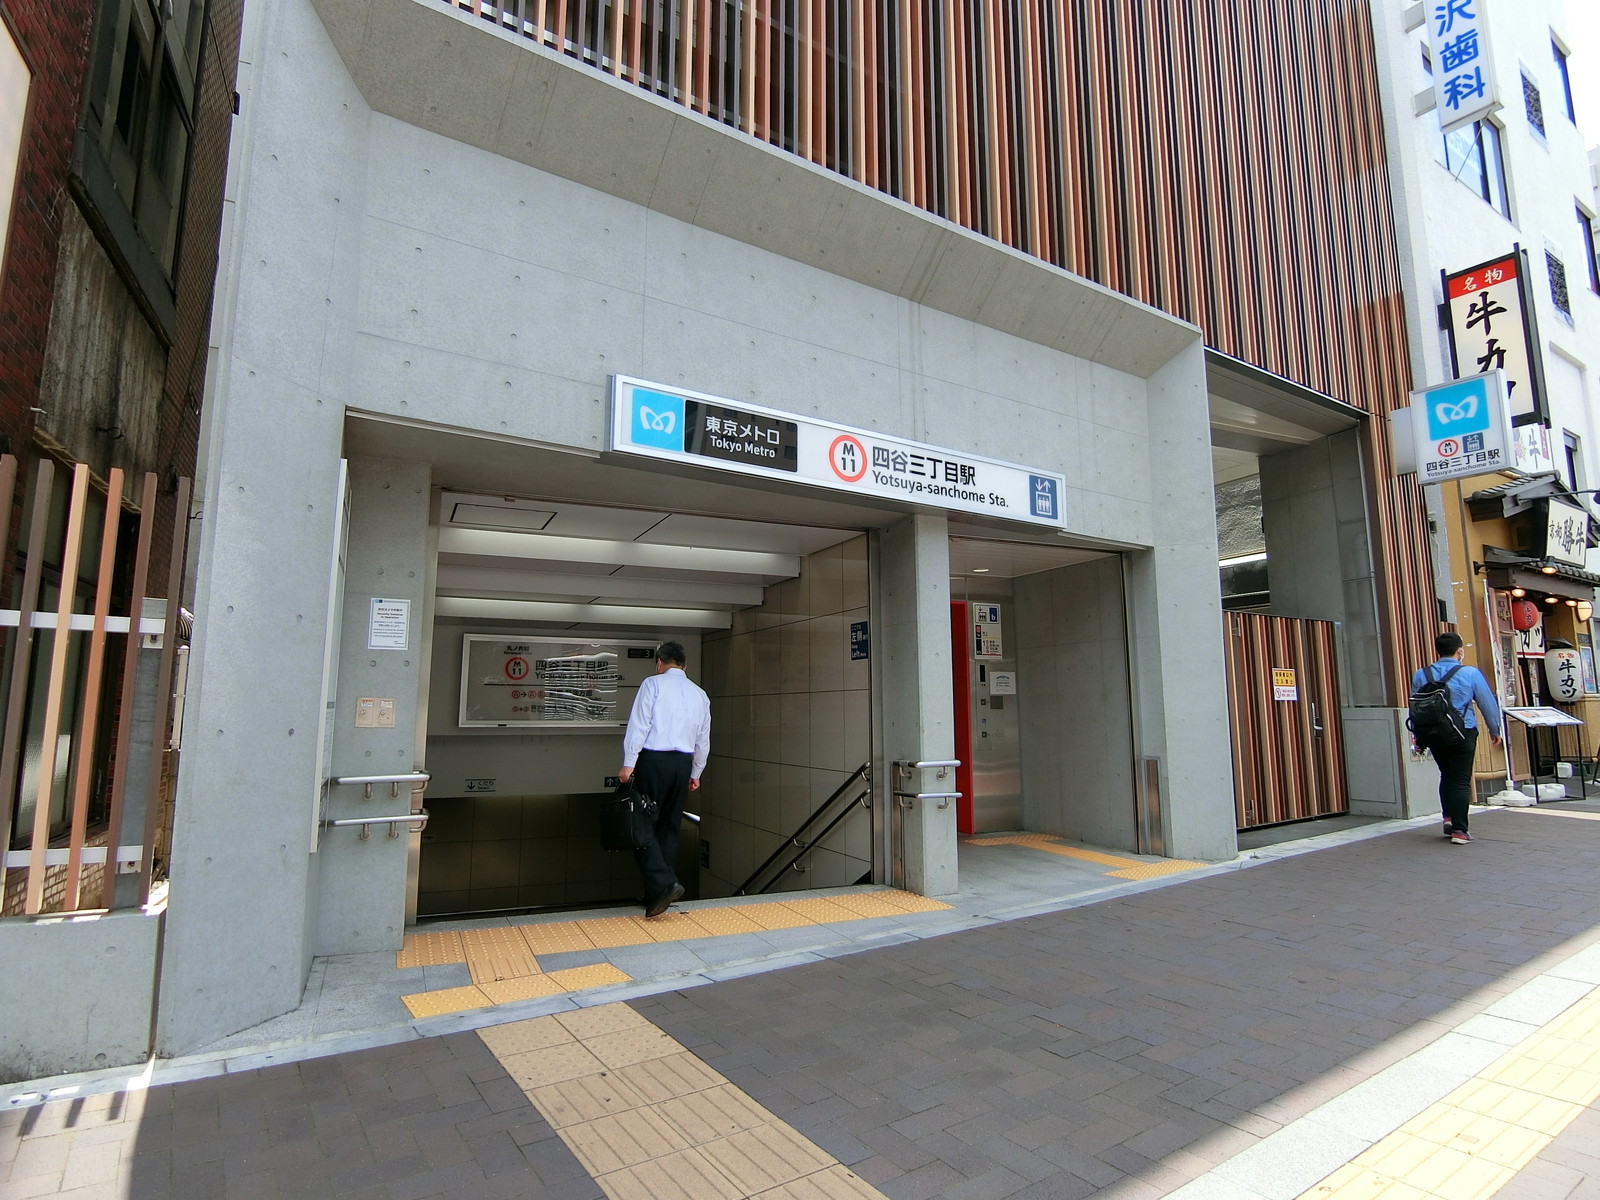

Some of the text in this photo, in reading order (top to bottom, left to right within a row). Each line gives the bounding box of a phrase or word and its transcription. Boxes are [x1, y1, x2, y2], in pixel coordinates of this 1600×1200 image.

[1434, 0, 1486, 111] 沢歯科
[1462, 268, 1503, 292] 名物
[1466, 291, 1517, 400] 牛カ
[705, 416, 780, 445] 東京メトロ
[710, 435, 776, 458] Tokyo Metro
[842, 442, 855, 457] M
[841, 456, 856, 473] 11
[872, 445, 976, 487] 四谷三丁目駅
[1426, 448, 1500, 472] 四谷三丁目駅
[1426, 463, 1487, 478] Yotsuya-sanchome
[872, 470, 1009, 508] Yotsuya-sanchome Sta.
[512, 668, 522, 676] 11
[513, 660, 521, 668] M
[1559, 659, 1578, 699] 牛カツ
